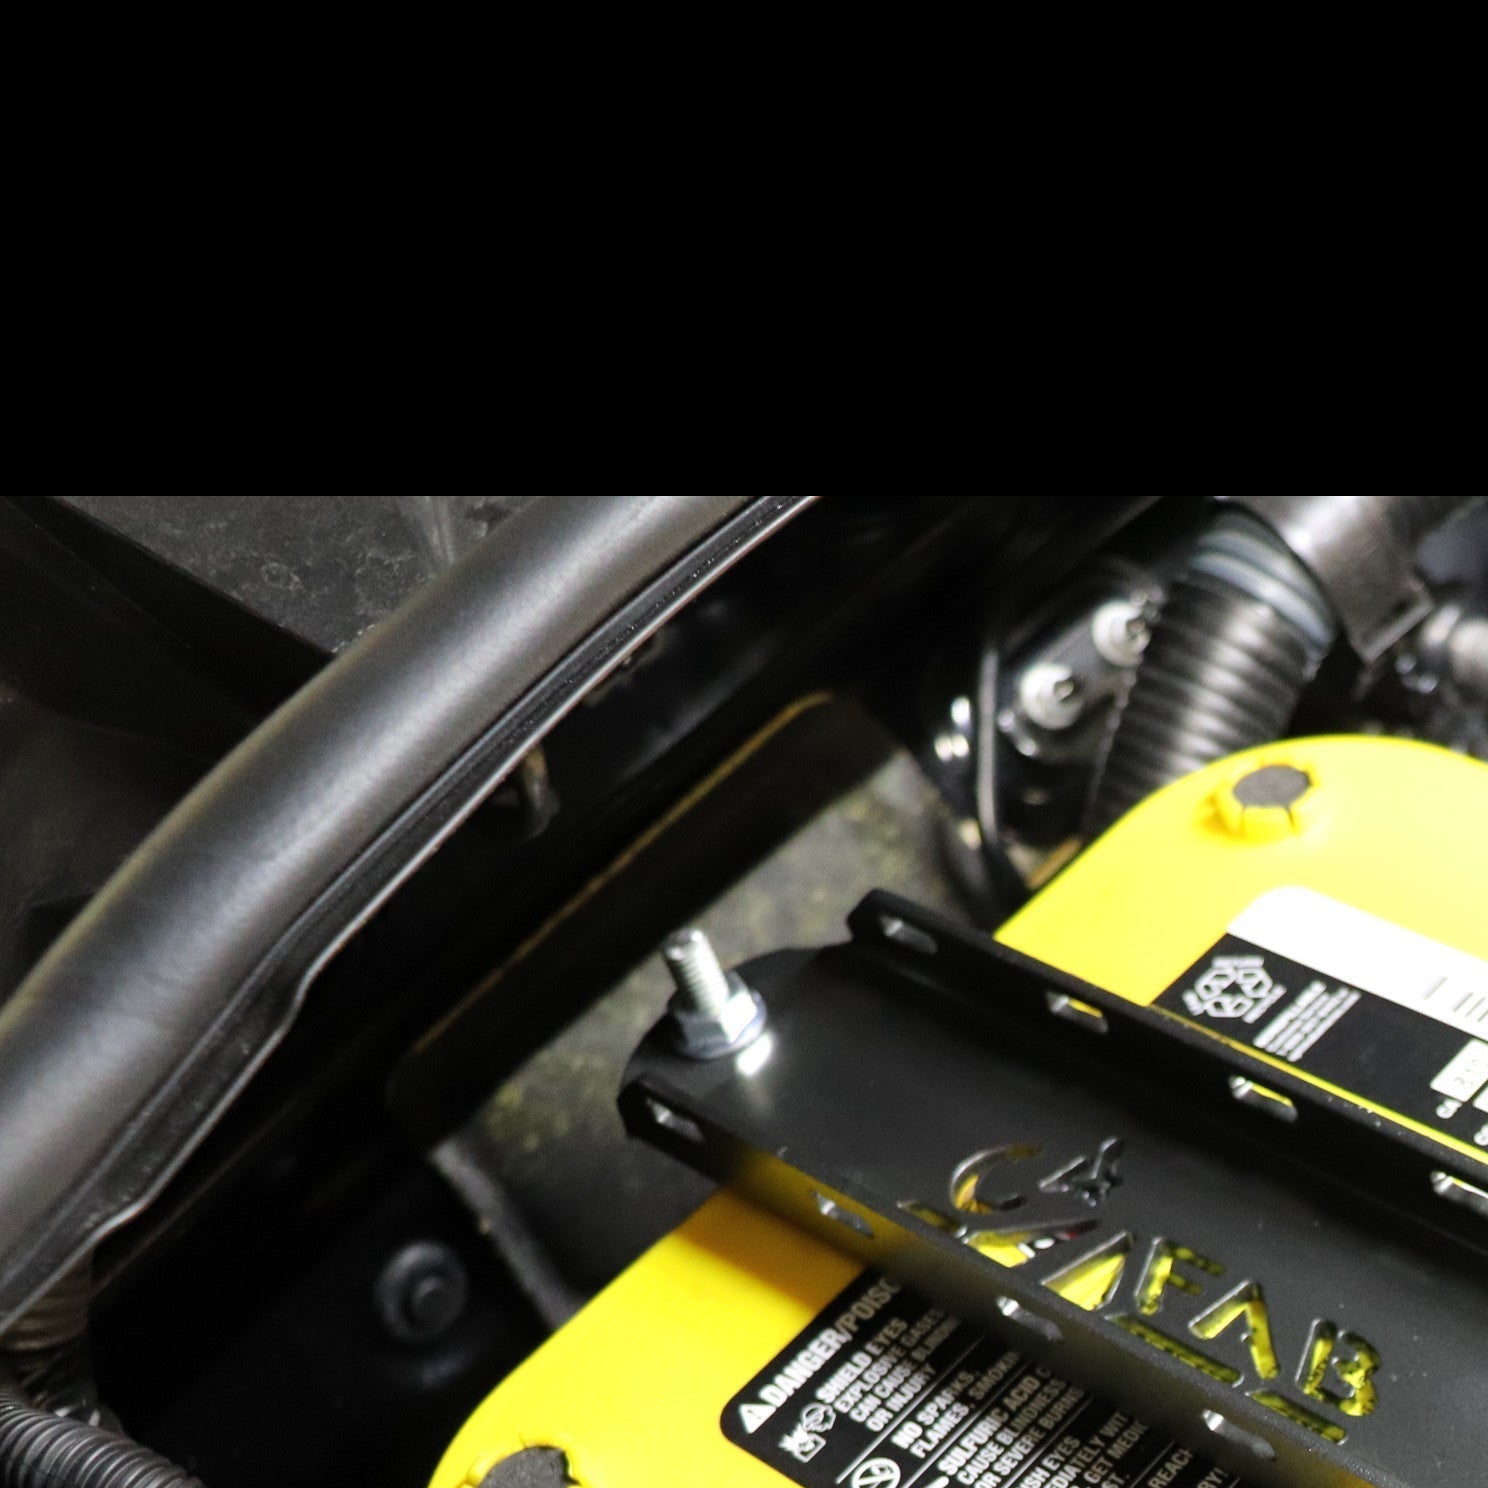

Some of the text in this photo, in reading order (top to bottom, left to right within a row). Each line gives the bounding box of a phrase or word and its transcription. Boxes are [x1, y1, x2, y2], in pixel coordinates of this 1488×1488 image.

[815, 1317, 908, 1404] SHIELD EYES
[833, 1346, 904, 1414] EXPLOSIVE
[850, 1394, 882, 1423] CAN
[875, 1360, 914, 1399] CAUSE
[866, 1362, 936, 1432] OR INJURY
[937, 1375, 1041, 1475] SULFURIC ACID
[1101, 1410, 1129, 1438] WIT
[891, 1420, 923, 1449] NO
[956, 1379, 1066, 1485] CAUSE BLINDNESS
[993, 1426, 1046, 1476] SEVERE
[1039, 1387, 1085, 1430] BURNS
[1042, 1435, 1081, 1471] EYES
[1084, 1456, 1114, 1484] GET
